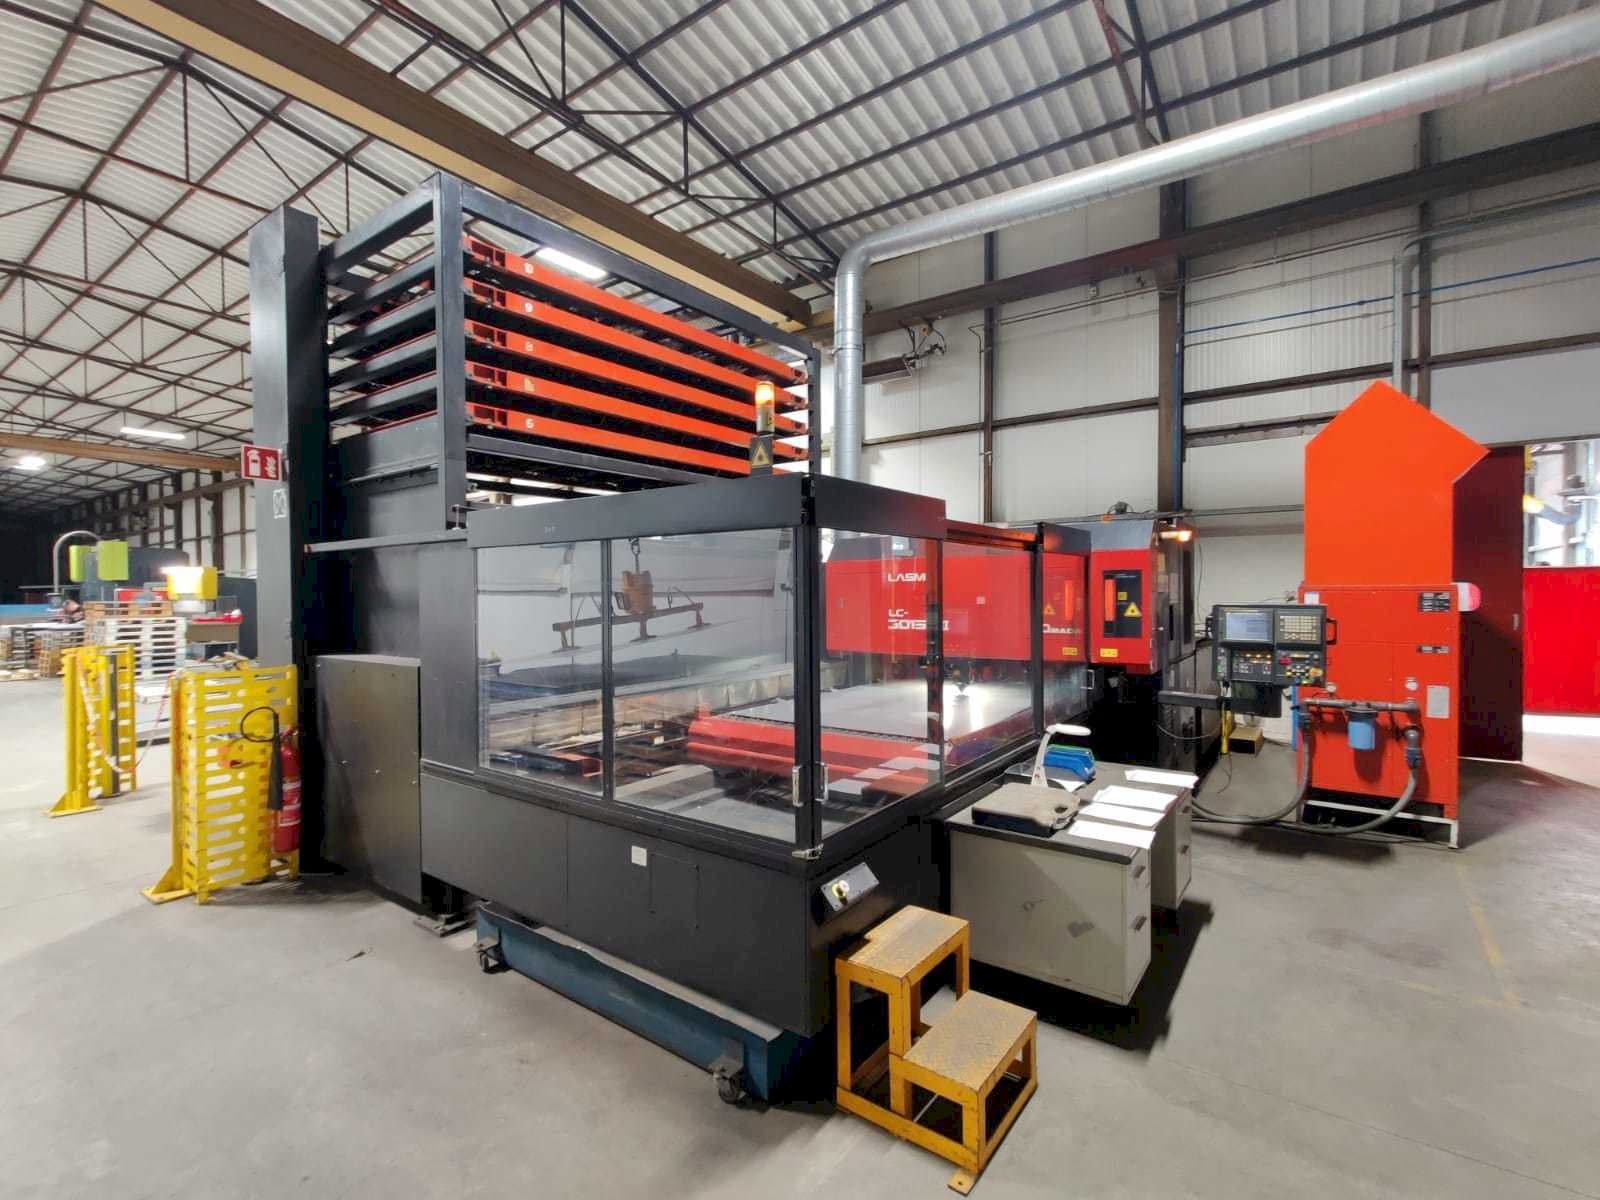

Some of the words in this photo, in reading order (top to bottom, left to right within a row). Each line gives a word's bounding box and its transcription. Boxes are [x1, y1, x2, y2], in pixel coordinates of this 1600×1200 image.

[526, 418, 534, 429] 6
[888, 572, 927, 582] LASM
[888, 609, 909, 618] LC-
